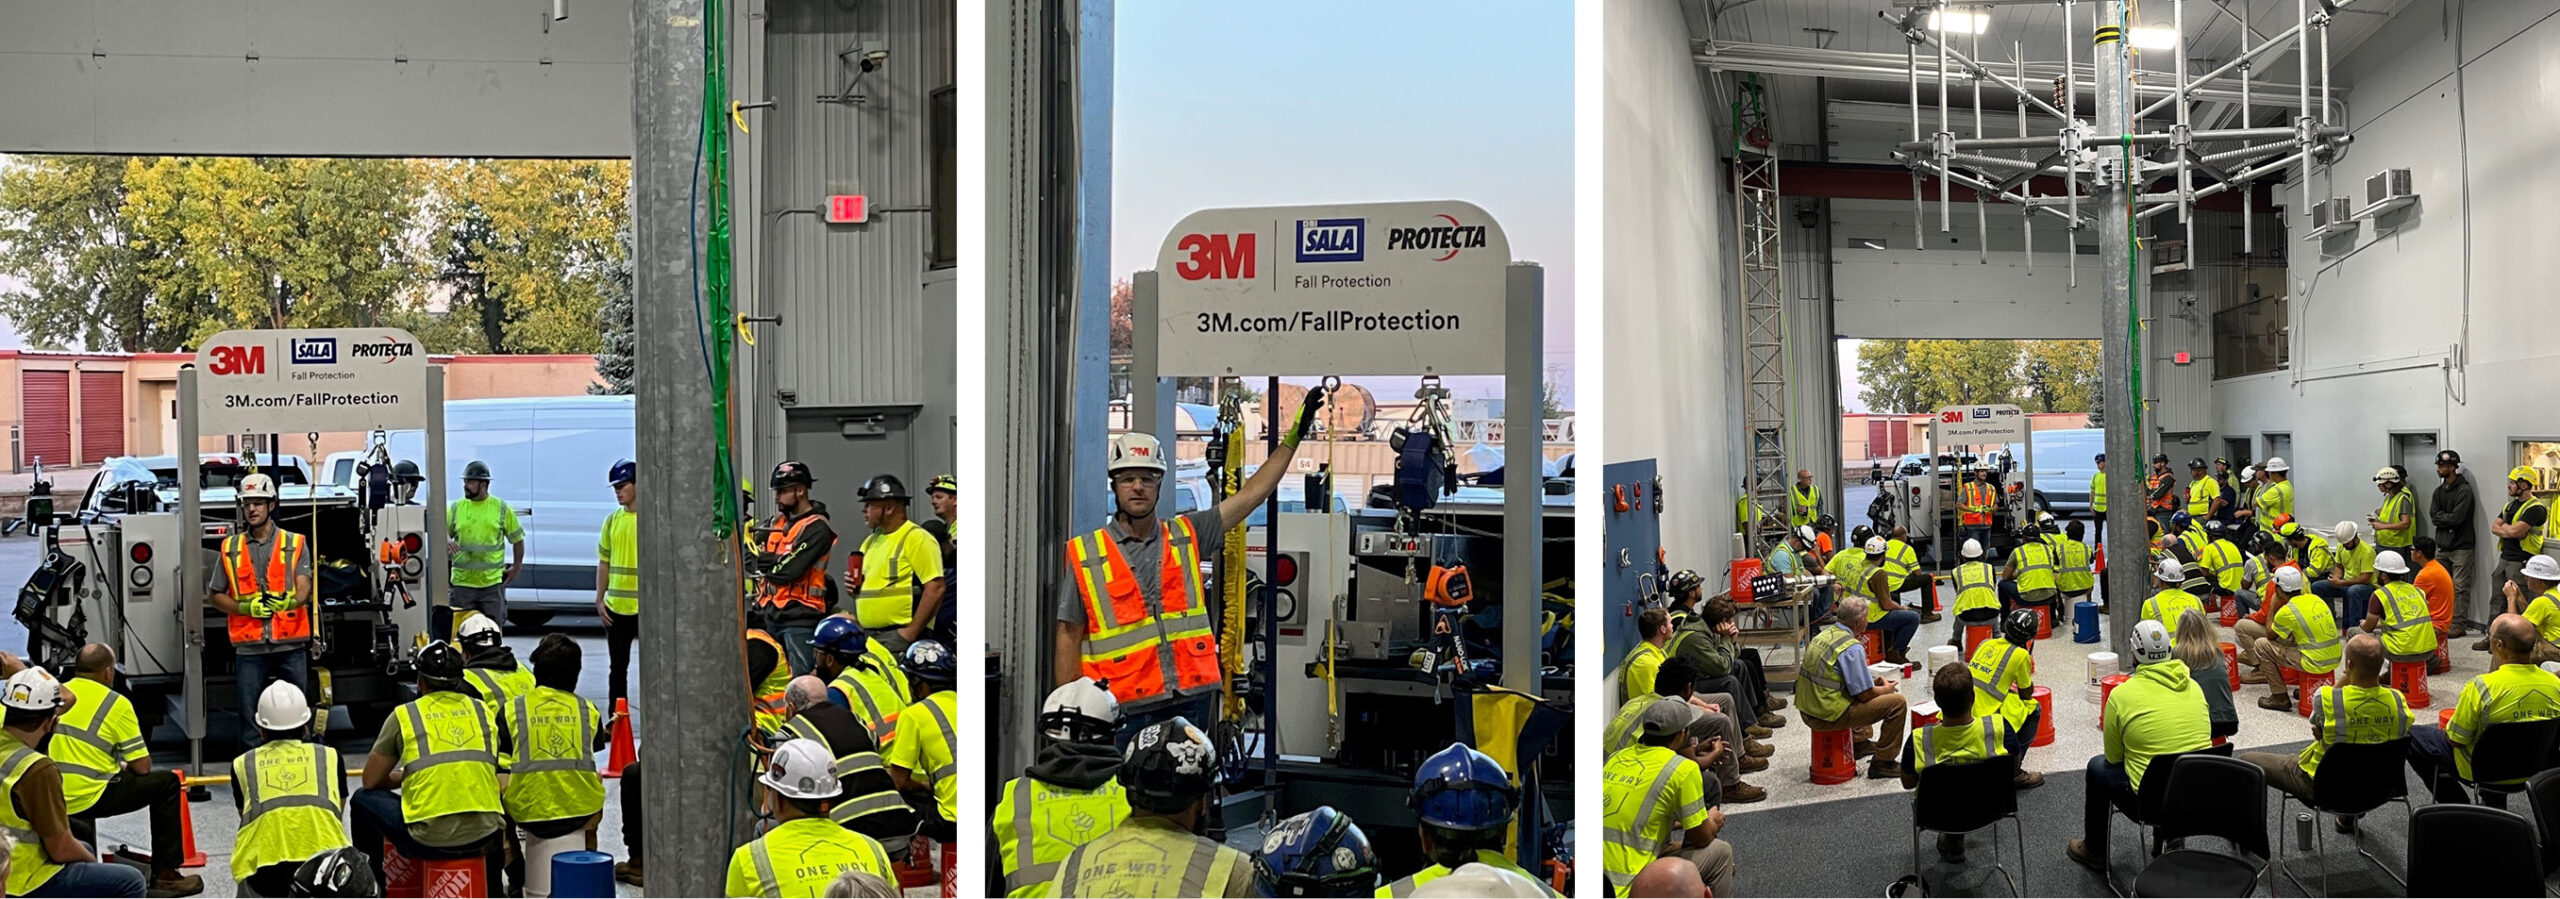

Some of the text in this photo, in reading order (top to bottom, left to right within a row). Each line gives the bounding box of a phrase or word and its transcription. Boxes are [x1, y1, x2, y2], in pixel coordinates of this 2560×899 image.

[1305, 229, 1355, 252] SALA
[1387, 225, 1486, 250] PROTECTA
[1175, 232, 1256, 281] 3M
[1295, 275, 1391, 289] Fall Protection
[1197, 309, 1460, 333] 3M.com/FallProtection
[298, 344, 331, 358] SALA
[352, 343, 413, 357] PROTECTA
[209, 346, 265, 376] 3M
[291, 371, 355, 381] Fall Protection
[225, 392, 399, 408] 3M.com/FallProtection
[1941, 411, 1963, 424] 3M
[1947, 428, 2015, 436] 3M.com/FallProtection
[1130, 447, 1149, 457] 3M
[530, 715, 576, 724] ONE WAY
[2350, 715, 2394, 725] ONE WAY
[2513, 710, 2533, 719] ONE
[259, 758, 281, 767] ONE
[1619, 775, 1643, 786] WAY
[795, 862, 869, 879] ONE WAY
[1082, 863, 1117, 880] ONE
[1128, 862, 1173, 875] WAY
